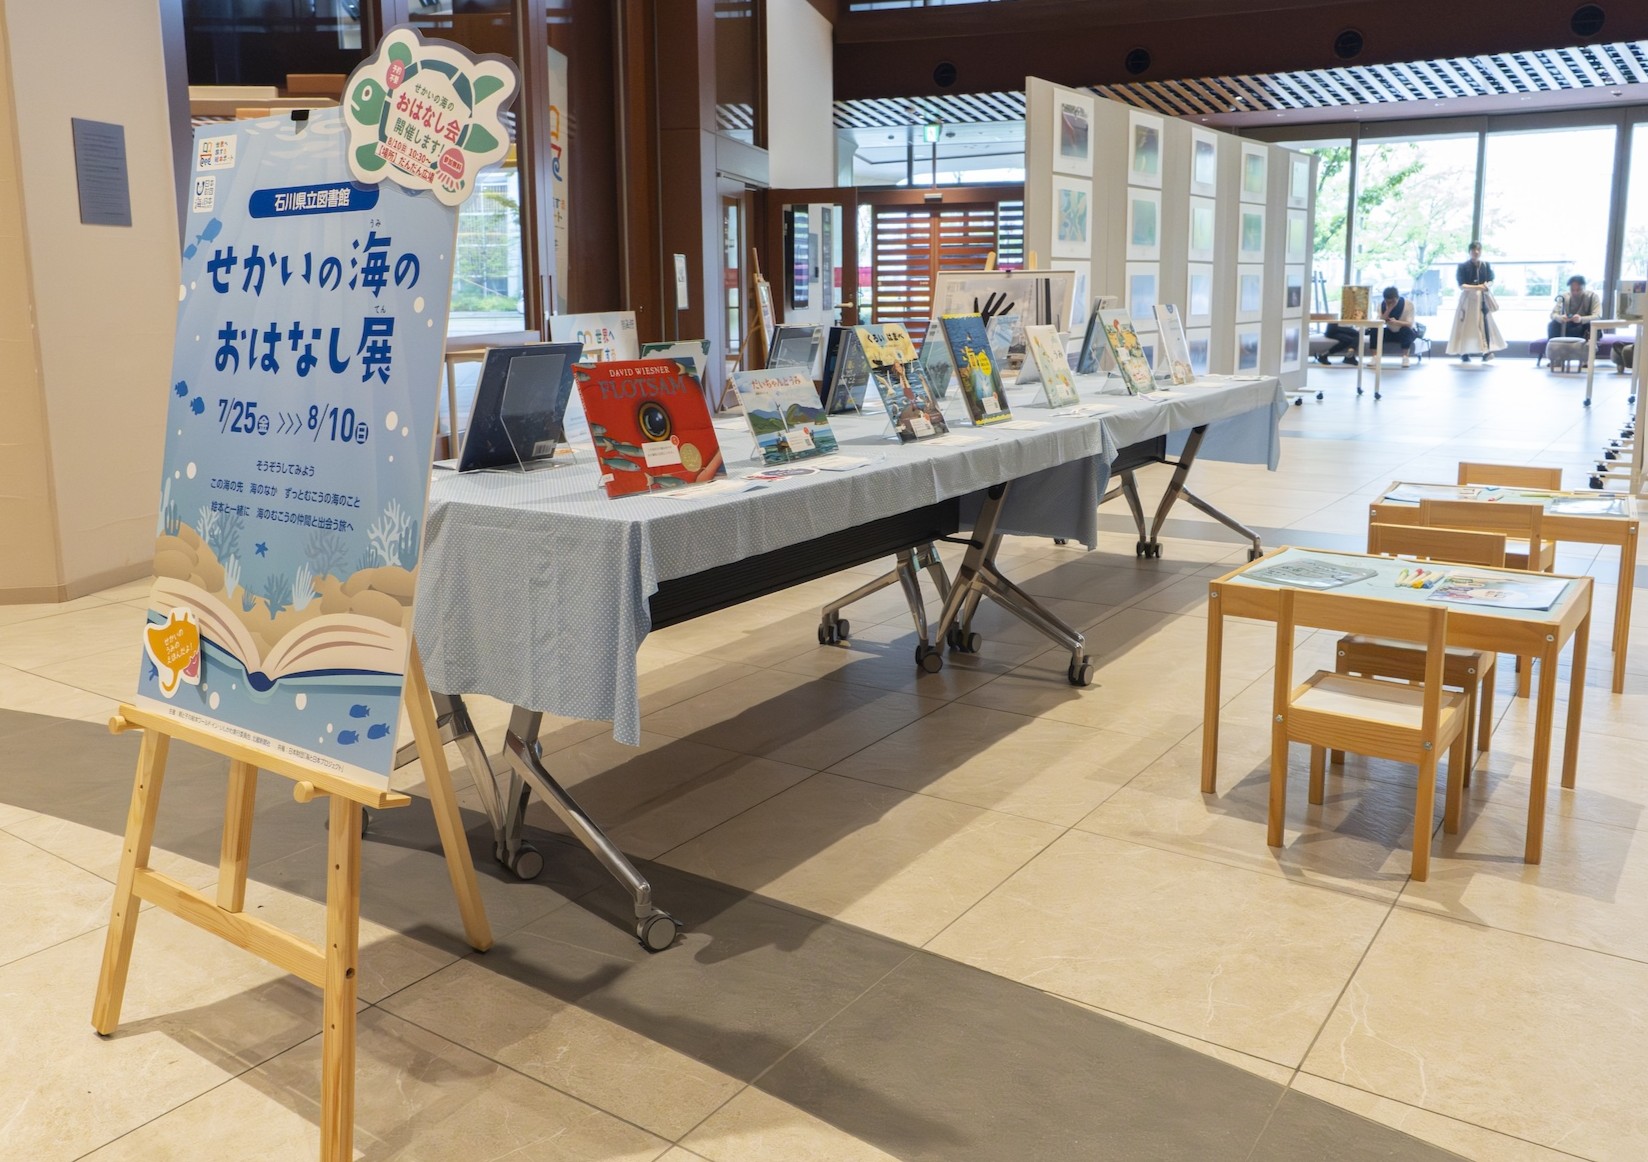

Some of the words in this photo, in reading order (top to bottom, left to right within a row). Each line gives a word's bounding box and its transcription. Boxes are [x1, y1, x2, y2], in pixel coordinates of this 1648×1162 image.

[415, 83, 455, 112] せかいの海の
[396, 92, 461, 143] おはなし会
[399, 156, 437, 184] だんだん広場
[274, 187, 350, 212] 石川県立図書館
[369, 218, 382, 228] うみ
[206, 231, 421, 298] せかいの海の
[374, 305, 386, 314] てん
[214, 316, 396, 384] おはなし展
[609, 367, 634, 378] DAVID
[635, 366, 670, 376] WIESNER
[598, 376, 688, 400] FLOTSAM
[256, 460, 315, 477] そうぞうしてみよう
[210, 478, 244, 493] この海の先
[249, 483, 278, 497] 海のなか
[284, 487, 361, 508] ずっとむこうの海のこと
[210, 500, 250, 518] 絵本と一緒に
[256, 507, 354, 533] 海のむこうの仲間と出会う旅へ
